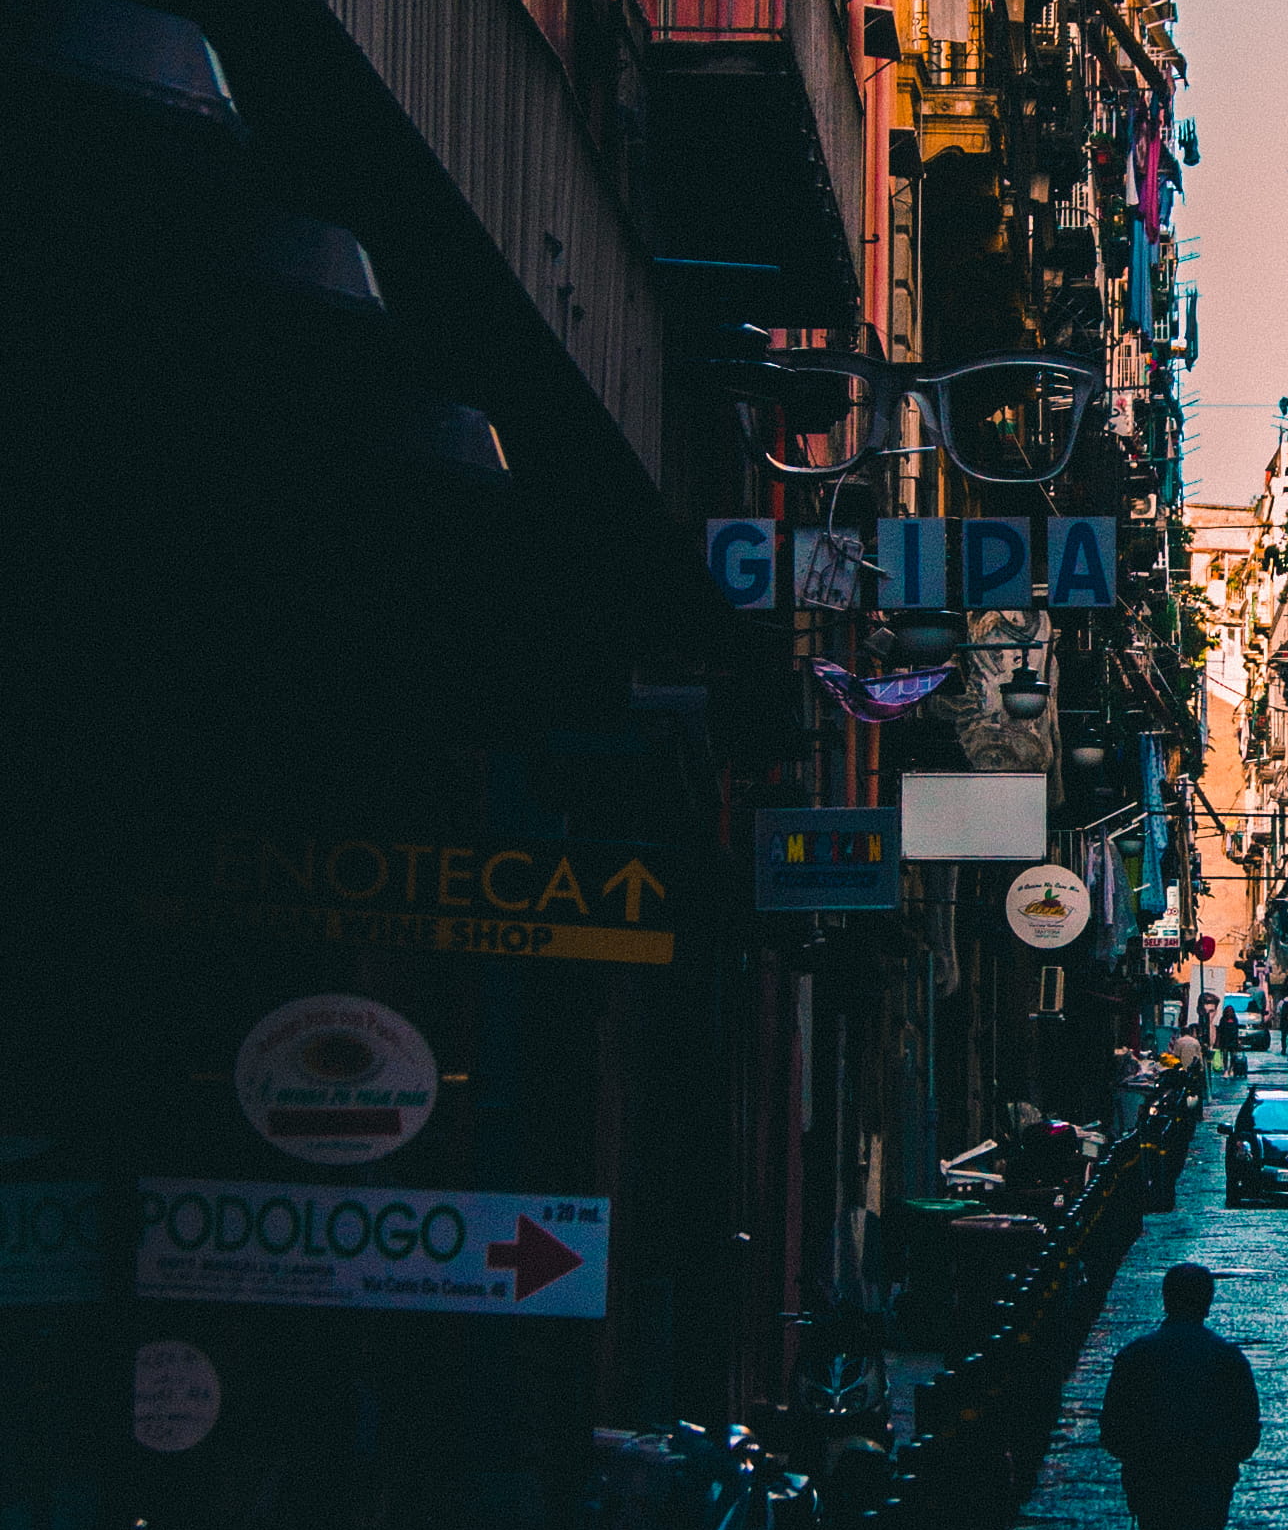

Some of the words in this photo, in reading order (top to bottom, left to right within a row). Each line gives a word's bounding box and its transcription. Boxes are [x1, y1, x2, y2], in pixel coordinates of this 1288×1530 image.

[214, 833, 590, 916] ENOTECA
[450, 920, 554, 954] SHOP
[1143, 938, 1162, 947] SELF
[139, 1191, 467, 1265] PODOLOGO
